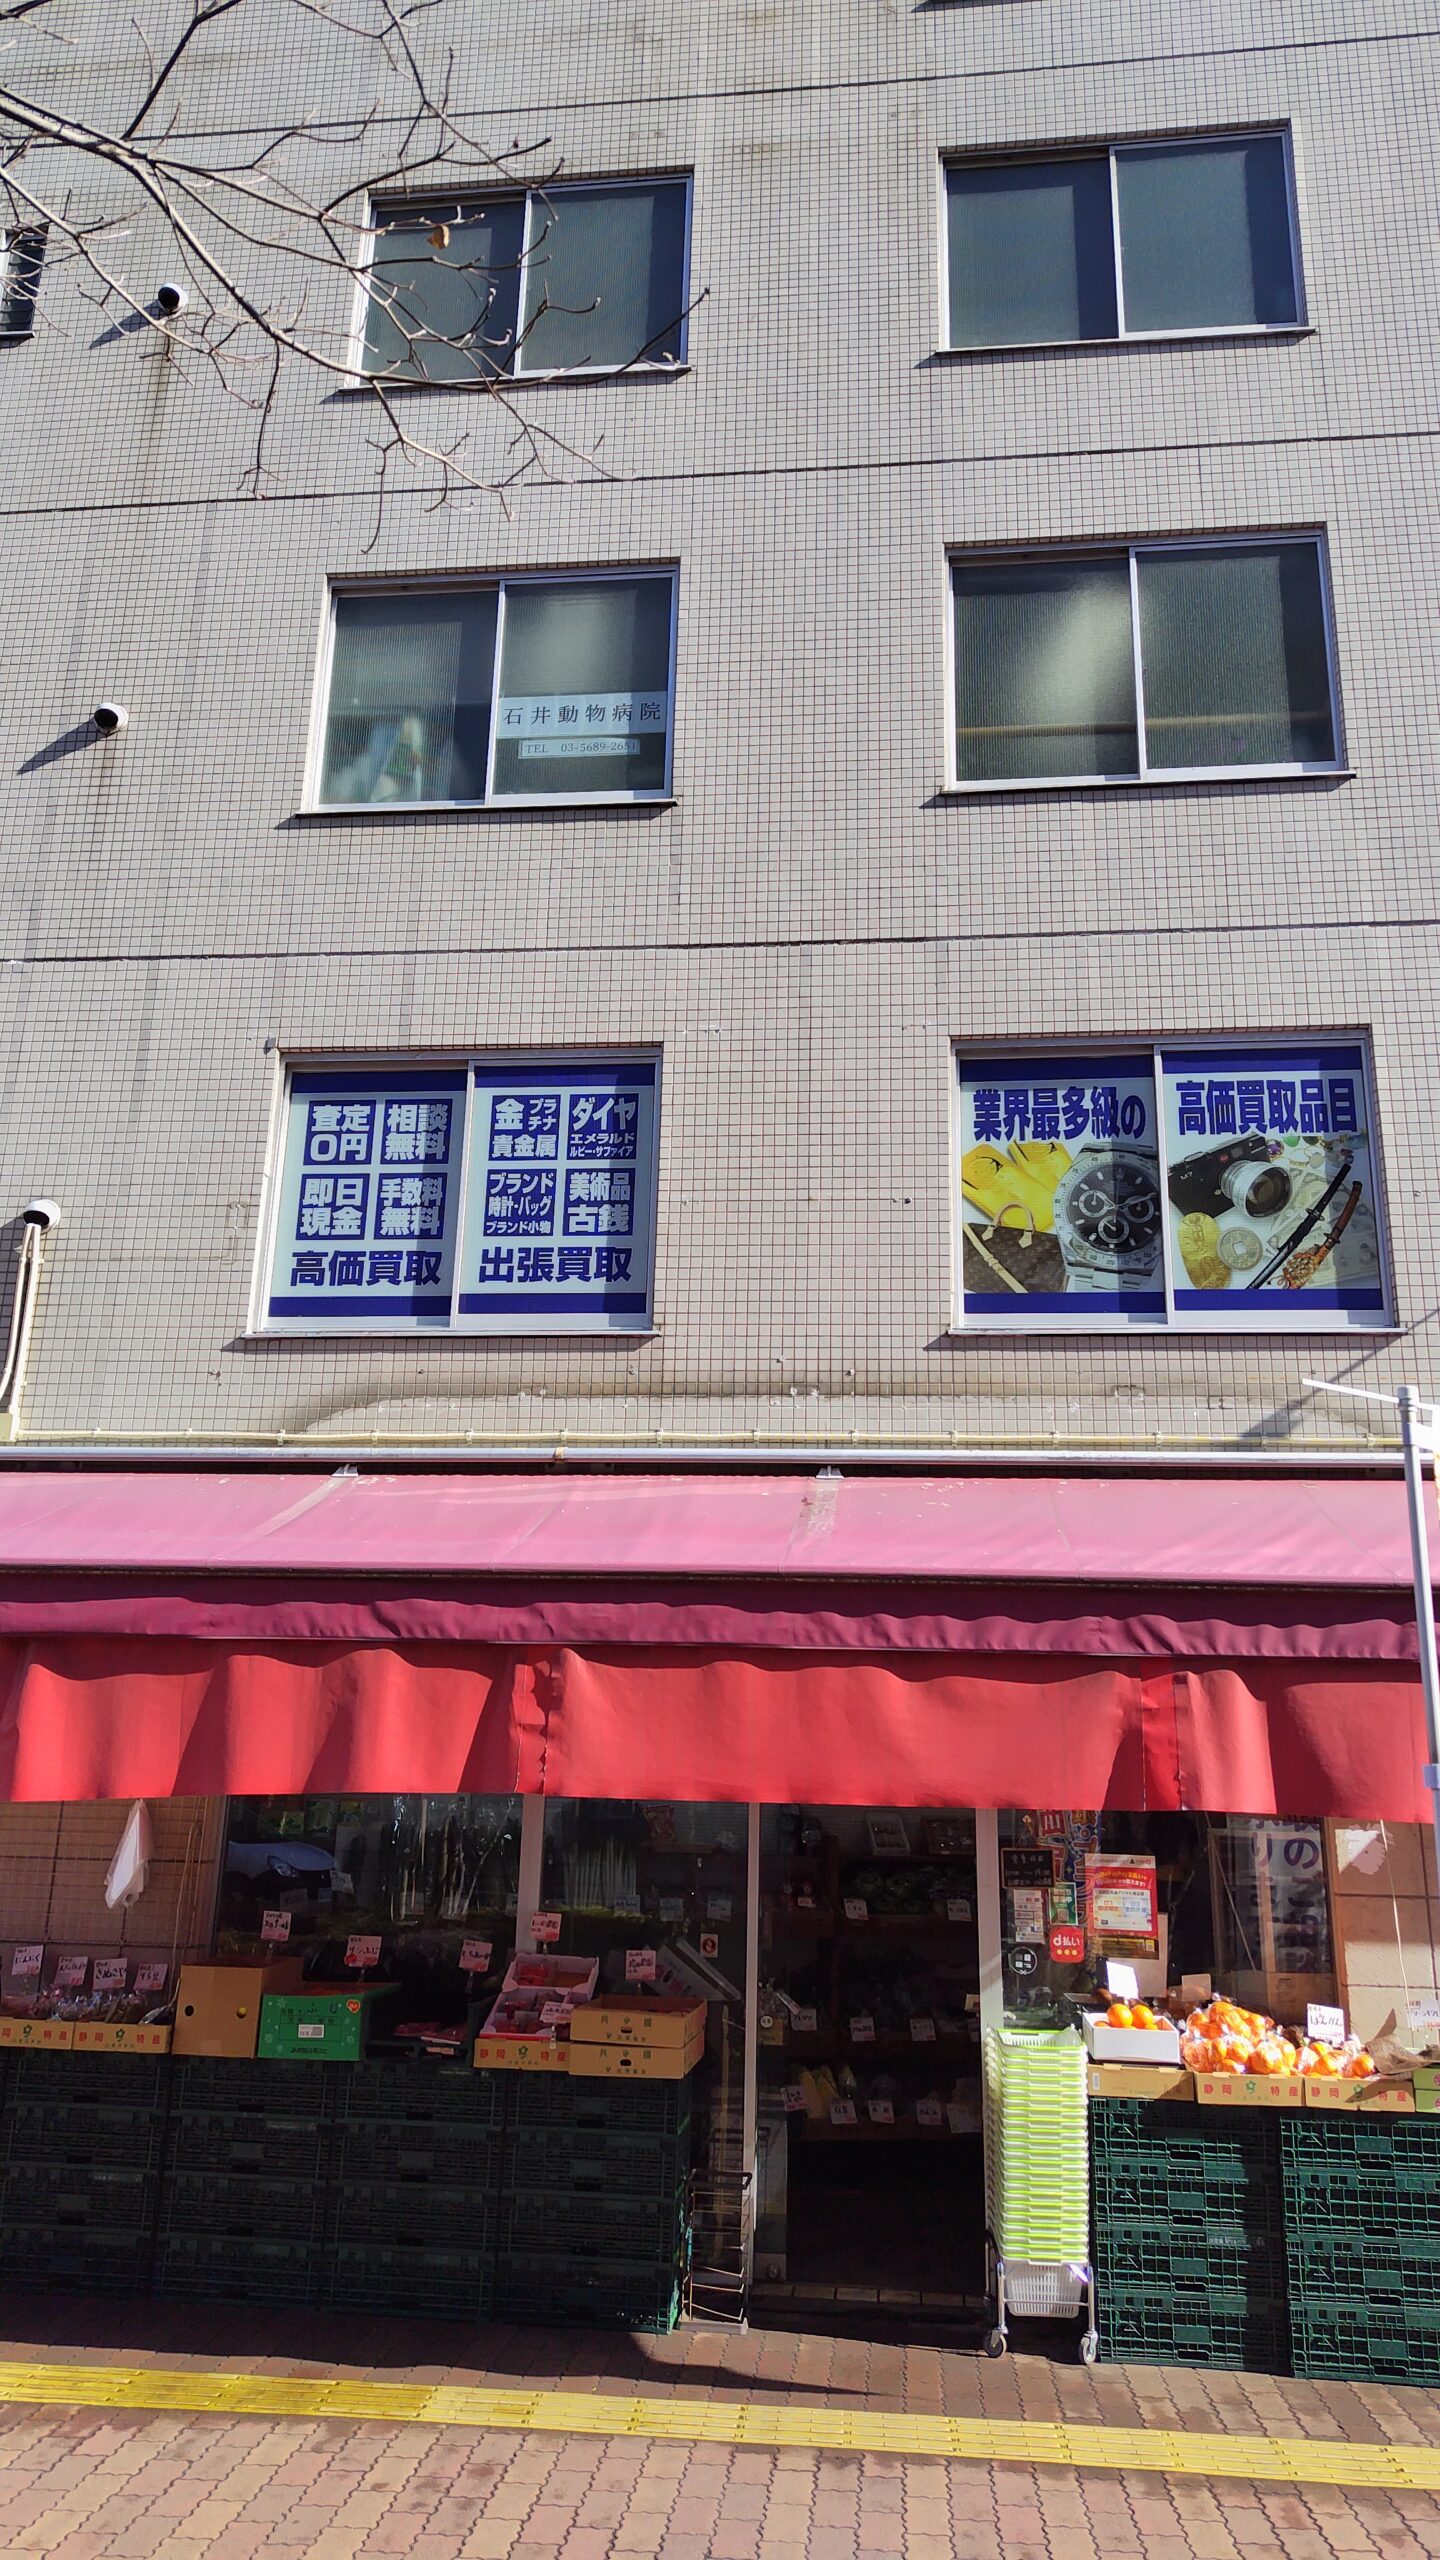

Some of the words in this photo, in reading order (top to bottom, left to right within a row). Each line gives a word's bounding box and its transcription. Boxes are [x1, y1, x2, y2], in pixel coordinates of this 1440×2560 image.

[503, 702, 661, 725] 石井動物病院
[526, 744, 548, 754] TEL
[561, 742, 636, 753] 03-5689-2651
[311, 1105, 371, 1132] 査定
[387, 1104, 449, 1132] 相談
[495, 1098, 523, 1130] 金
[571, 1097, 635, 1131] ダイヤ
[973, 1086, 1146, 1142] 業界最多級の
[1176, 1078, 1358, 1136] 高価買取品目
[384, 1133, 446, 1161] 無料
[491, 1134, 557, 1159] 貴金属
[569, 1132, 635, 1145] エメラルド
[569, 1145, 634, 1158] ルビー・サファイア
[303, 1177, 363, 1205] 即日
[380, 1176, 443, 1202] 手数料
[489, 1171, 554, 1195] ブランド
[569, 1172, 631, 1201] 美術品
[488, 1195, 553, 1218] 時計・バッグ
[567, 1205, 630, 1233] 古銭
[299, 1207, 363, 1236] 現金
[379, 1207, 440, 1236] 無料
[486, 1220, 551, 1234] ブランド小物
[291, 1250, 442, 1287] 高価買取
[479, 1246, 632, 1284] 出張買取
[1053, 1934, 1080, 1946] d払い
